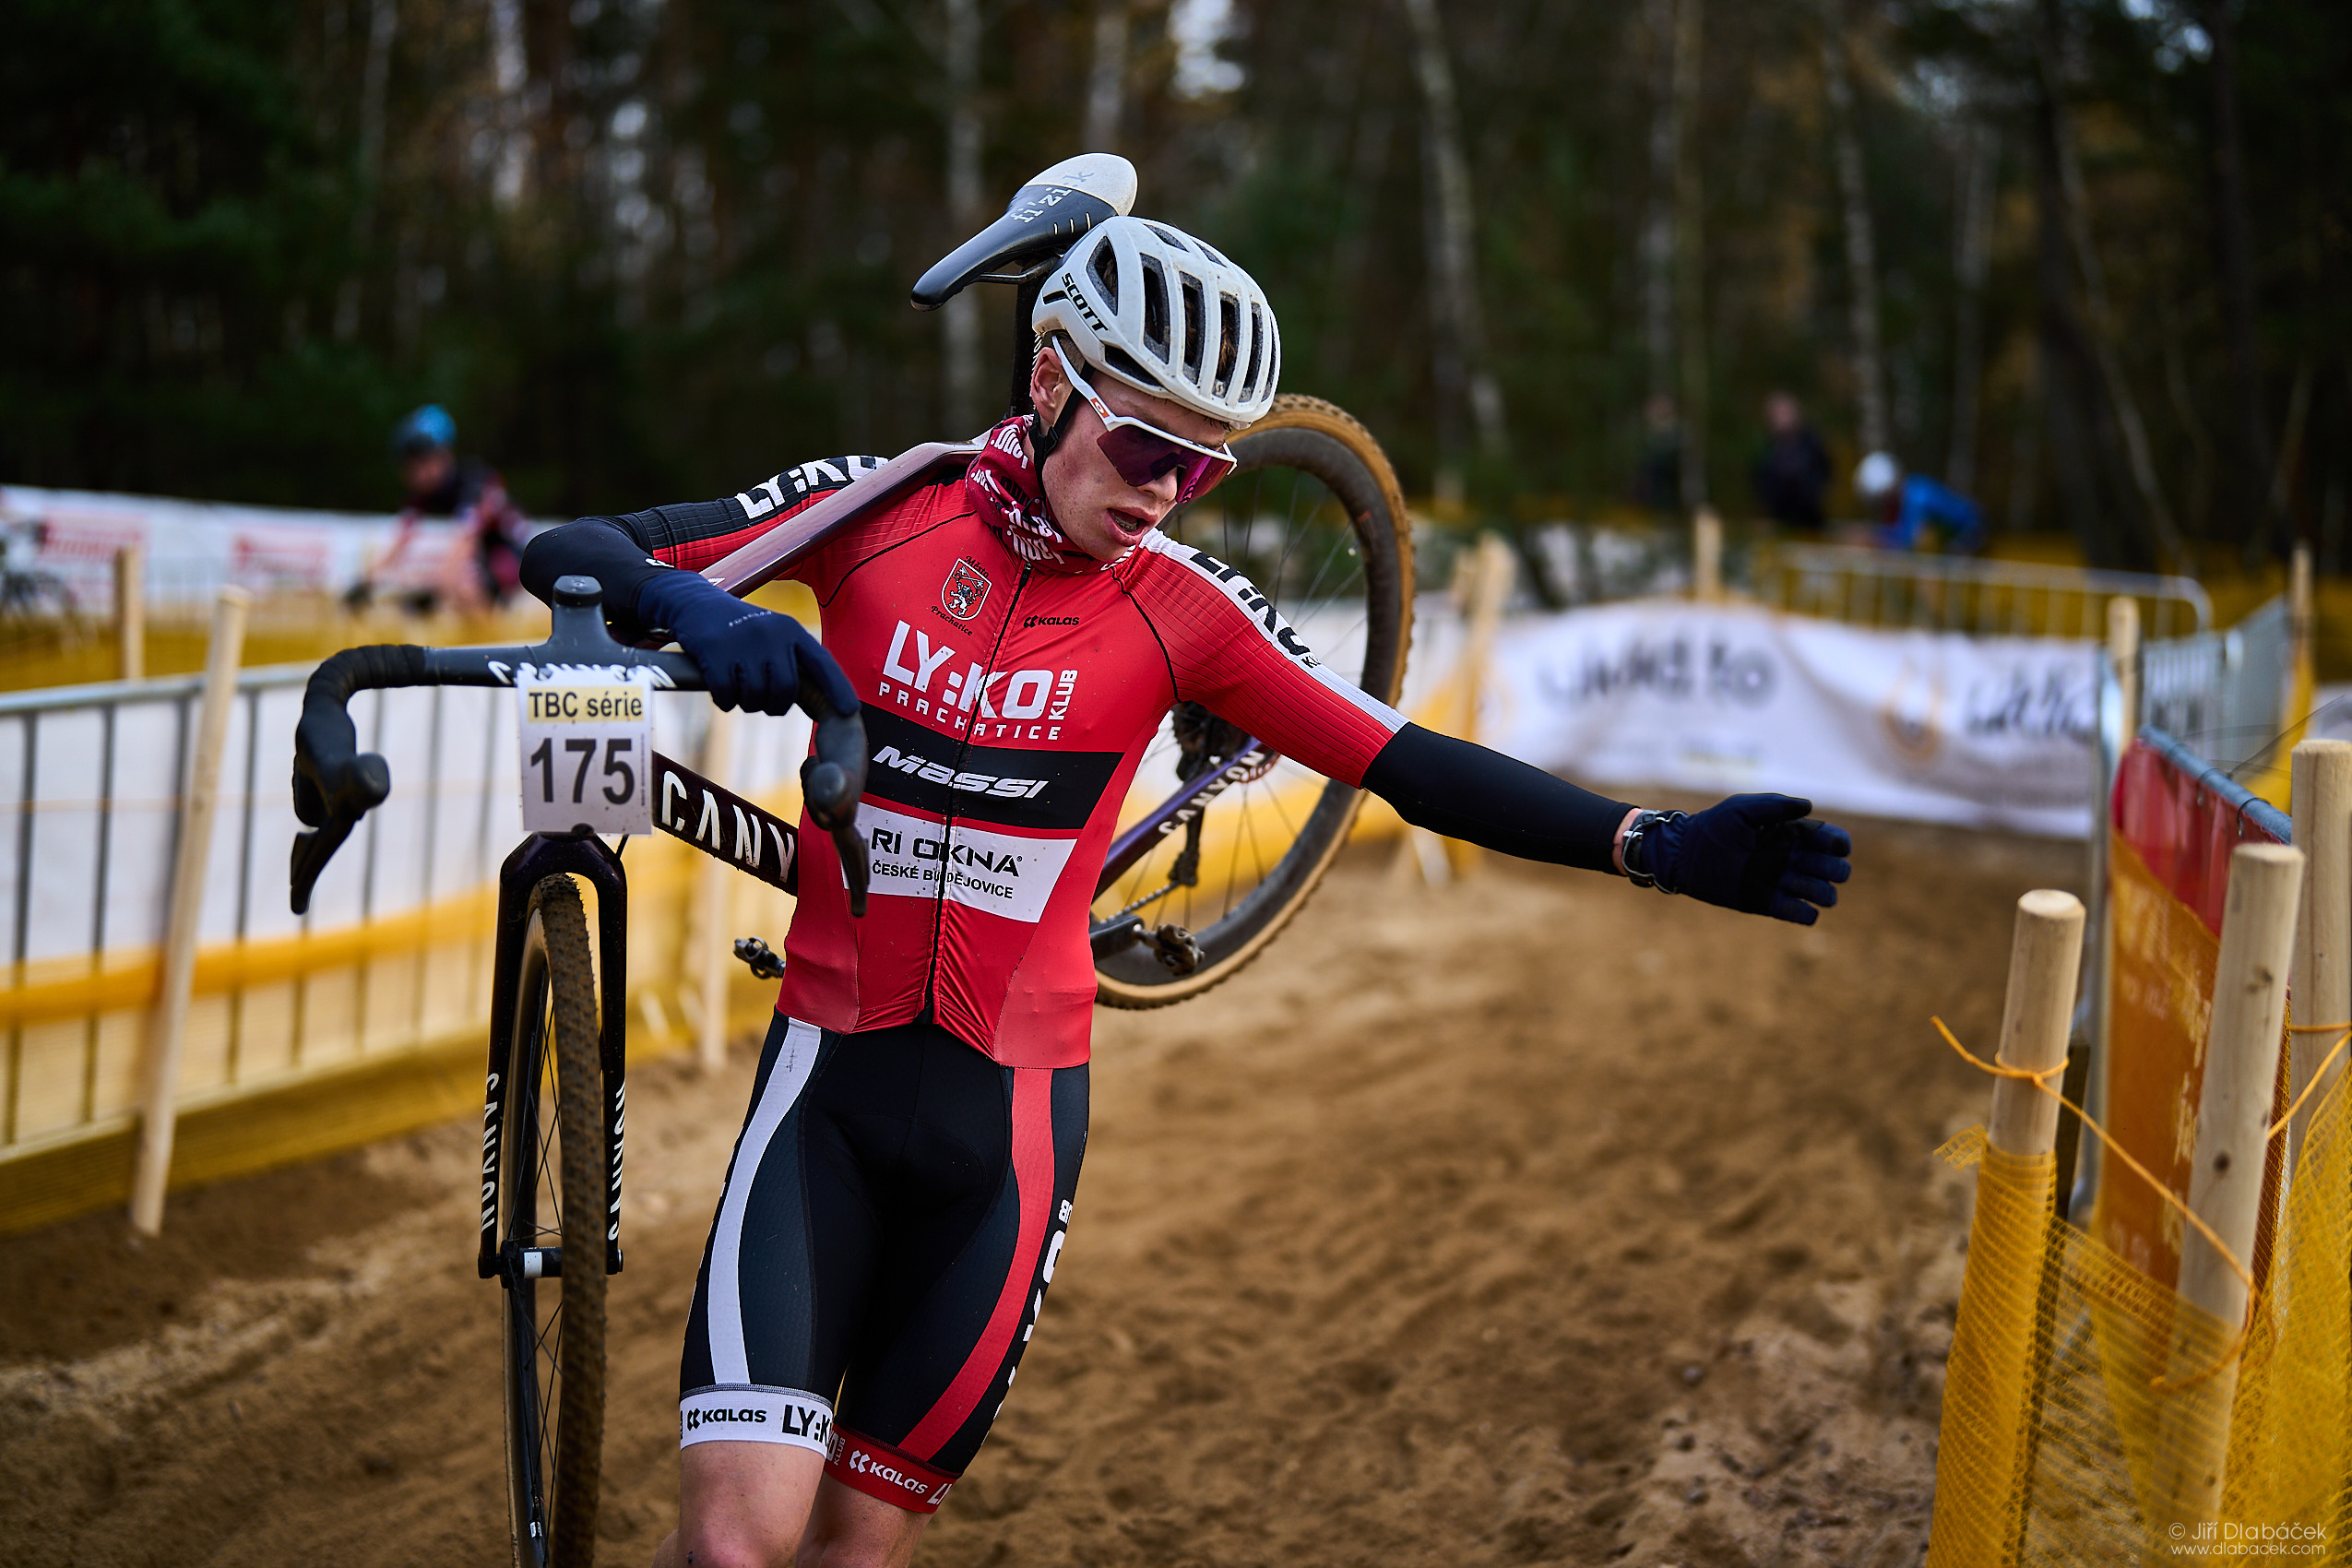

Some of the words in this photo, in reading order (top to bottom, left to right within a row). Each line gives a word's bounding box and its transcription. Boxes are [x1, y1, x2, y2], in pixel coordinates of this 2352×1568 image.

[1062, 272, 1109, 331] SCOTT
[964, 555, 990, 578] Město
[931, 605, 973, 636] Prachatice
[883, 619, 1054, 720] LY:KO
[529, 692, 578, 719] TBC
[587, 690, 643, 718] série
[878, 681, 1062, 741] PRACHATICE
[1048, 669, 1078, 720] KLUB
[529, 737, 636, 806] 175
[1158, 749, 1265, 834] CANYON
[871, 826, 903, 855] RI
[872, 860, 919, 880] ČESKÉ
[833, 1437, 846, 1466] KLUB
